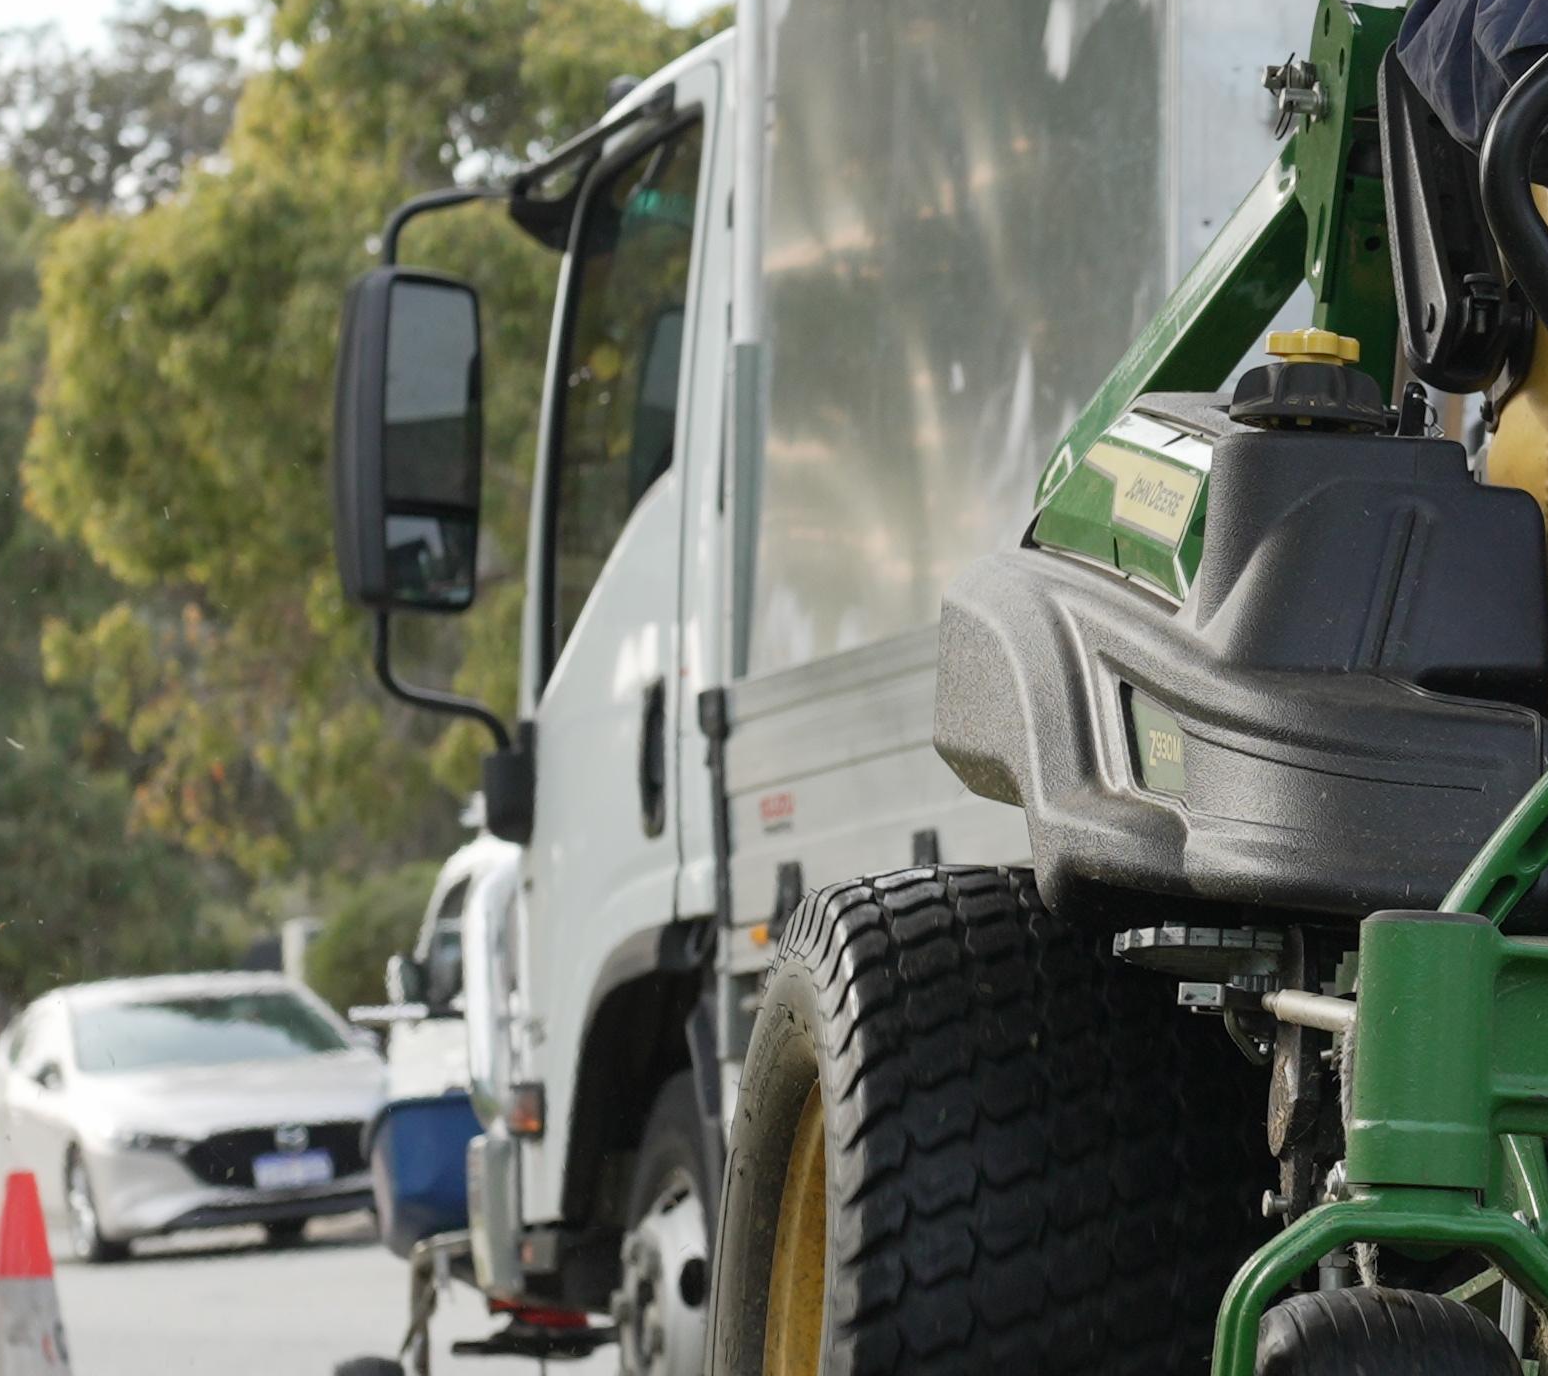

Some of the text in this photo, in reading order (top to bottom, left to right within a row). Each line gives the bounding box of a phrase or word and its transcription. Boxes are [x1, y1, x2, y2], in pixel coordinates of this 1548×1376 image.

[1124, 472, 1185, 517] JOHN DEERE
[1148, 729, 1181, 768] Z930M
